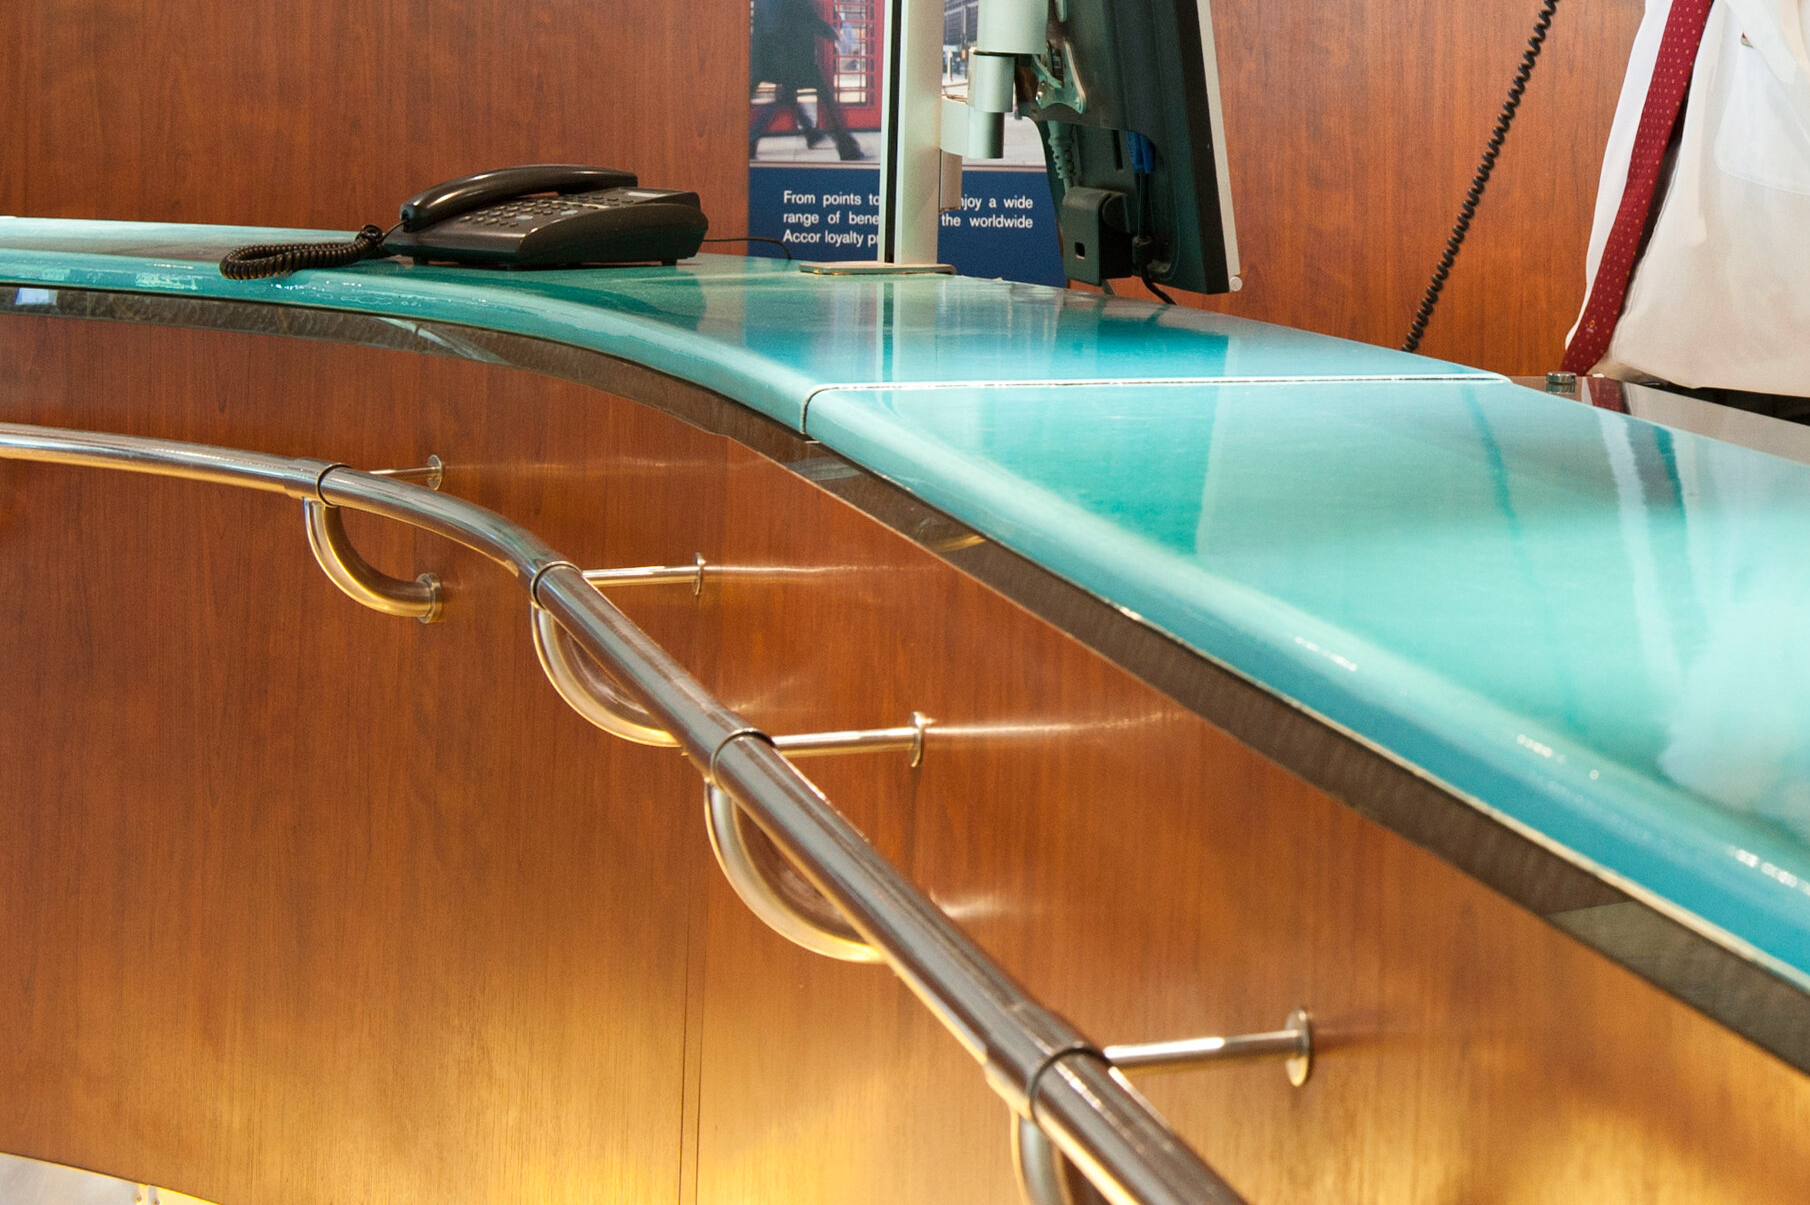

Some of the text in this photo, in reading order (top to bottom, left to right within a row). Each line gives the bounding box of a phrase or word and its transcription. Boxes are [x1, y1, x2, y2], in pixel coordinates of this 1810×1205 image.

[784, 190, 816, 204] From
[823, 192, 862, 208] points
[989, 198, 997, 208] a
[1003, 195, 1033, 209] wide
[783, 212, 819, 227] range
[828, 210, 840, 224] of
[941, 213, 961, 226] the
[969, 213, 1033, 228] worldwide
[783, 229, 821, 243] Accor
[825, 230, 864, 247] loyalty
